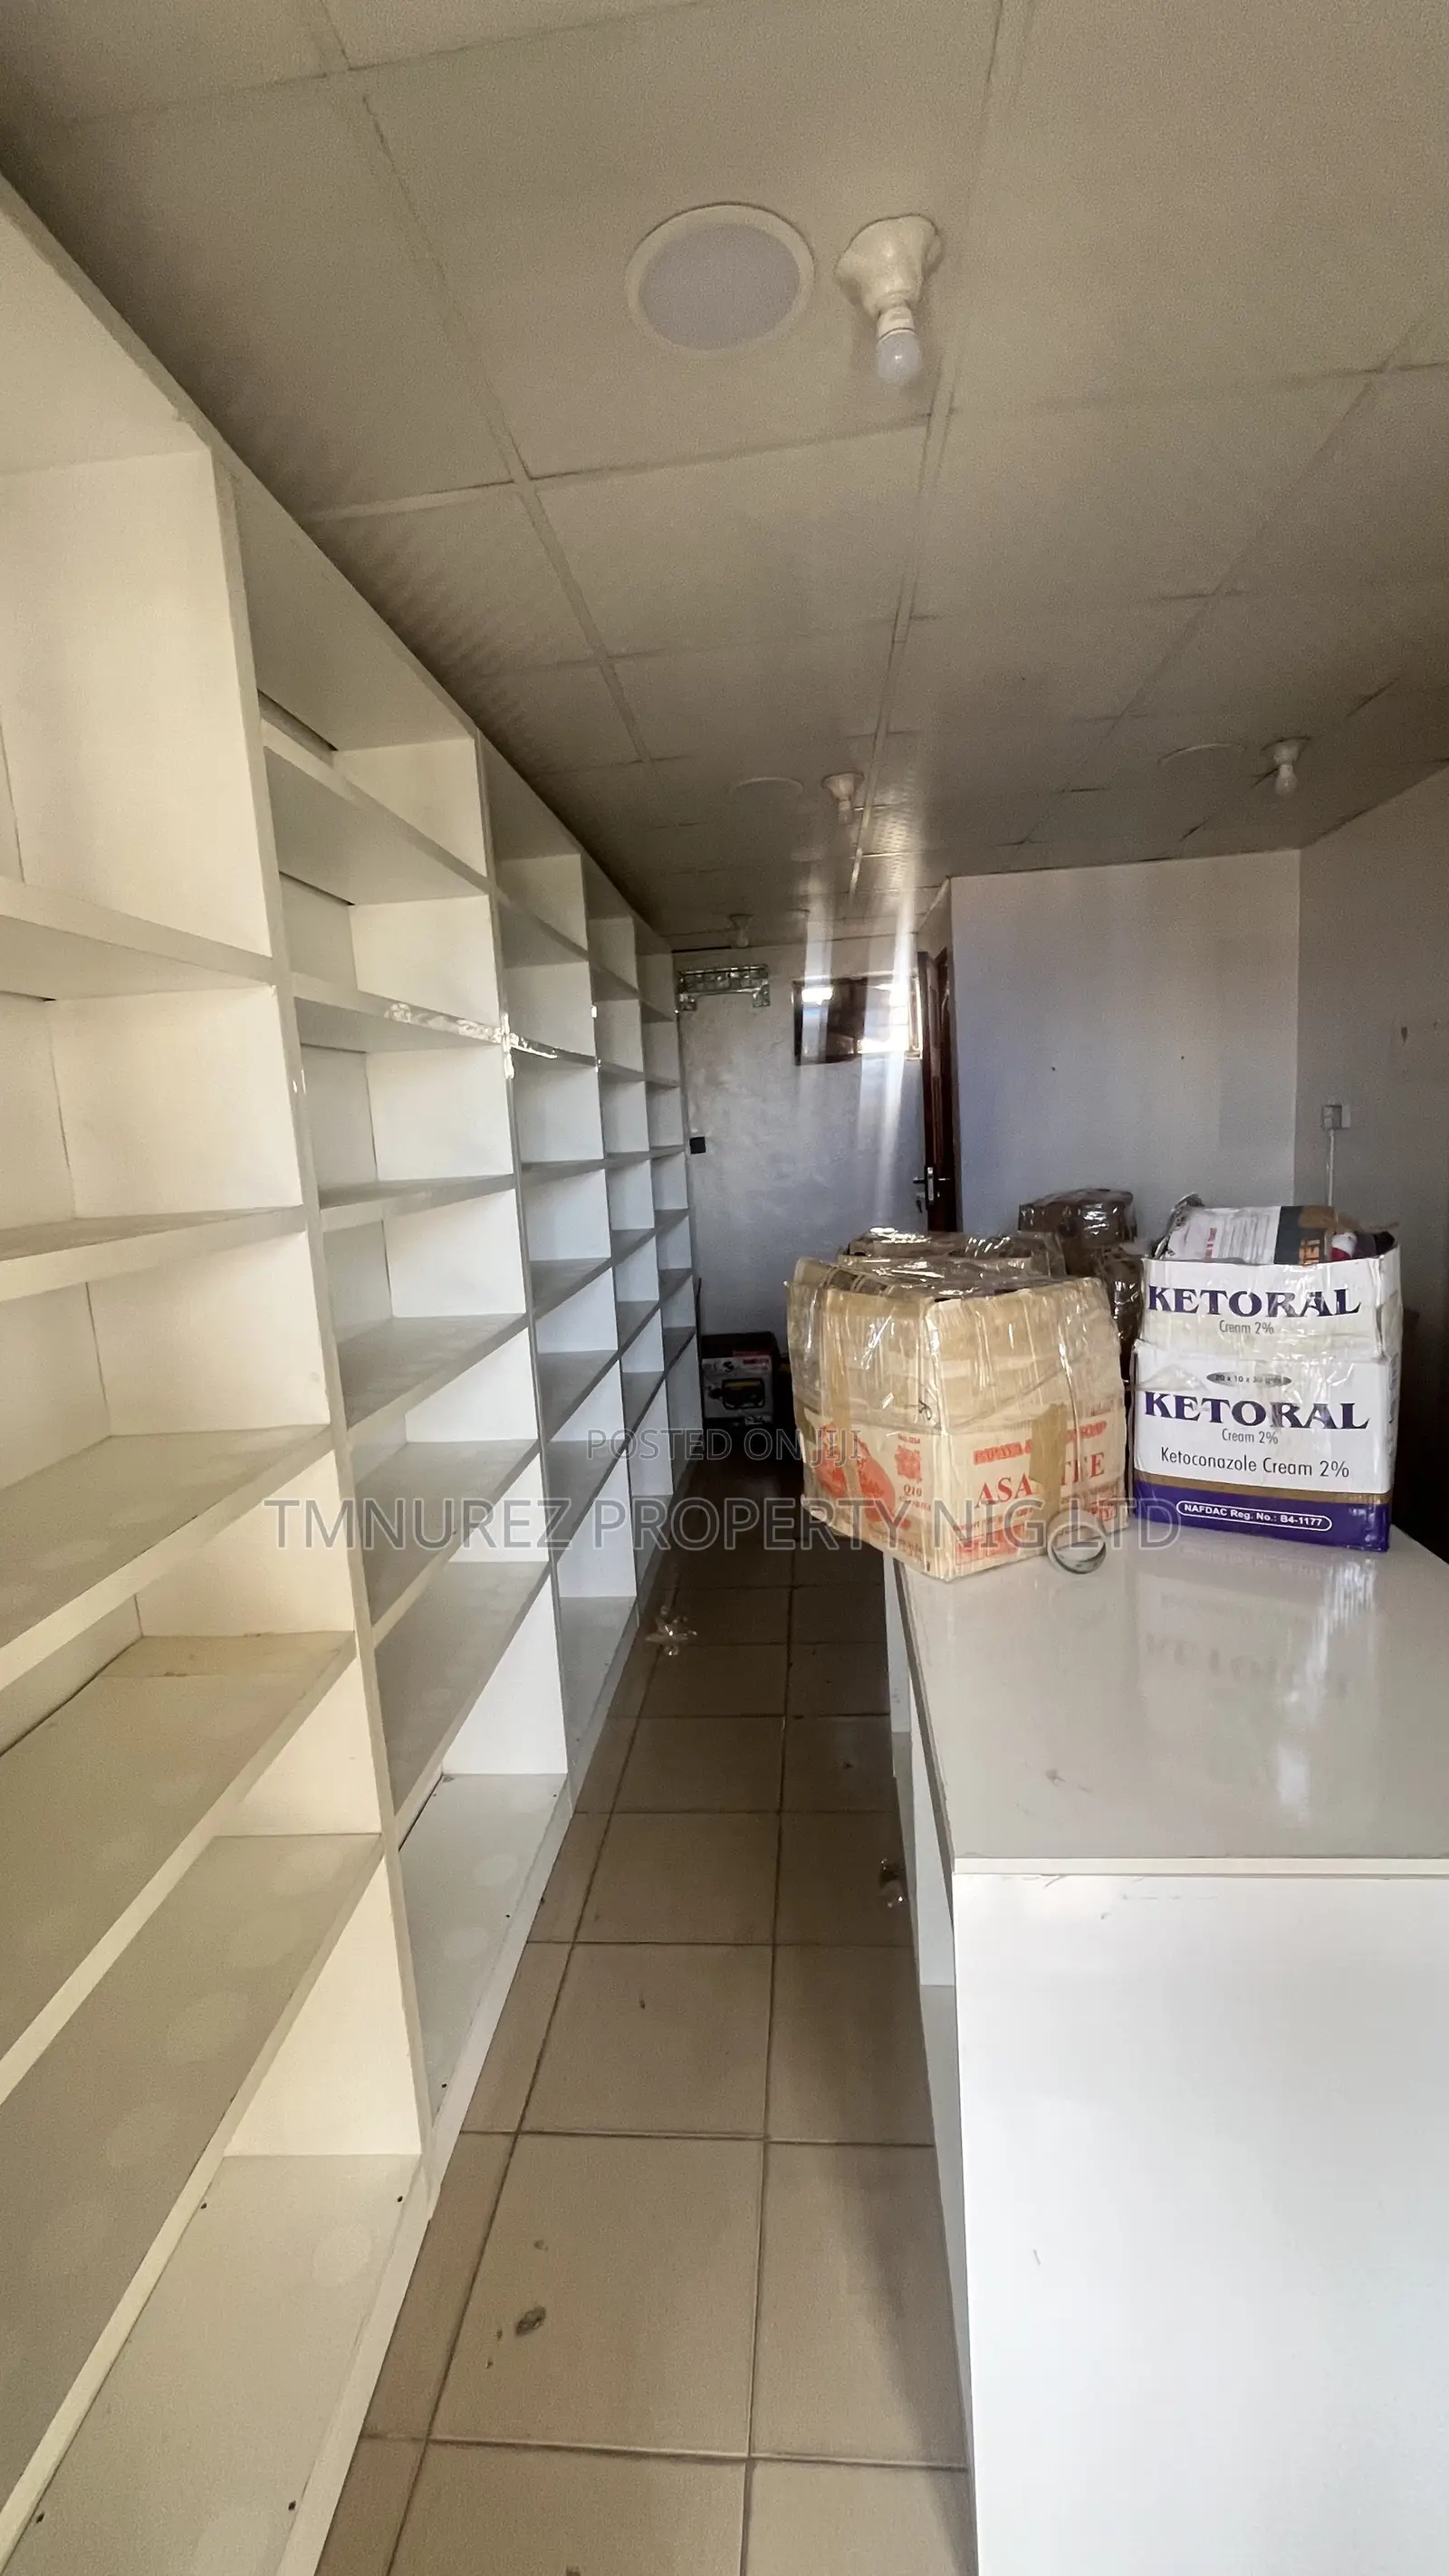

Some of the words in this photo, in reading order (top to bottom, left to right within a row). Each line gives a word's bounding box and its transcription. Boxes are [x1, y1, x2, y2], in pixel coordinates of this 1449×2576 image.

[1148, 1285, 1361, 1317] KETORAL
[1219, 1320, 1251, 1334] Cream
[1255, 1322, 1274, 1335] 2%
[1145, 1391, 1370, 1430] KETORAL
[1222, 1428, 1254, 1443] Cream
[1258, 1431, 1279, 1444] 2%
[1161, 1446, 1257, 1472] Ketoconazole
[1262, 1457, 1312, 1477] Cream
[1319, 1460, 1349, 1478] 2%
[1184, 1503, 1227, 1516] NAFDAC
[1230, 1509, 1253, 1520] Reg.
[1280, 1515, 1323, 1527] B4-1177
